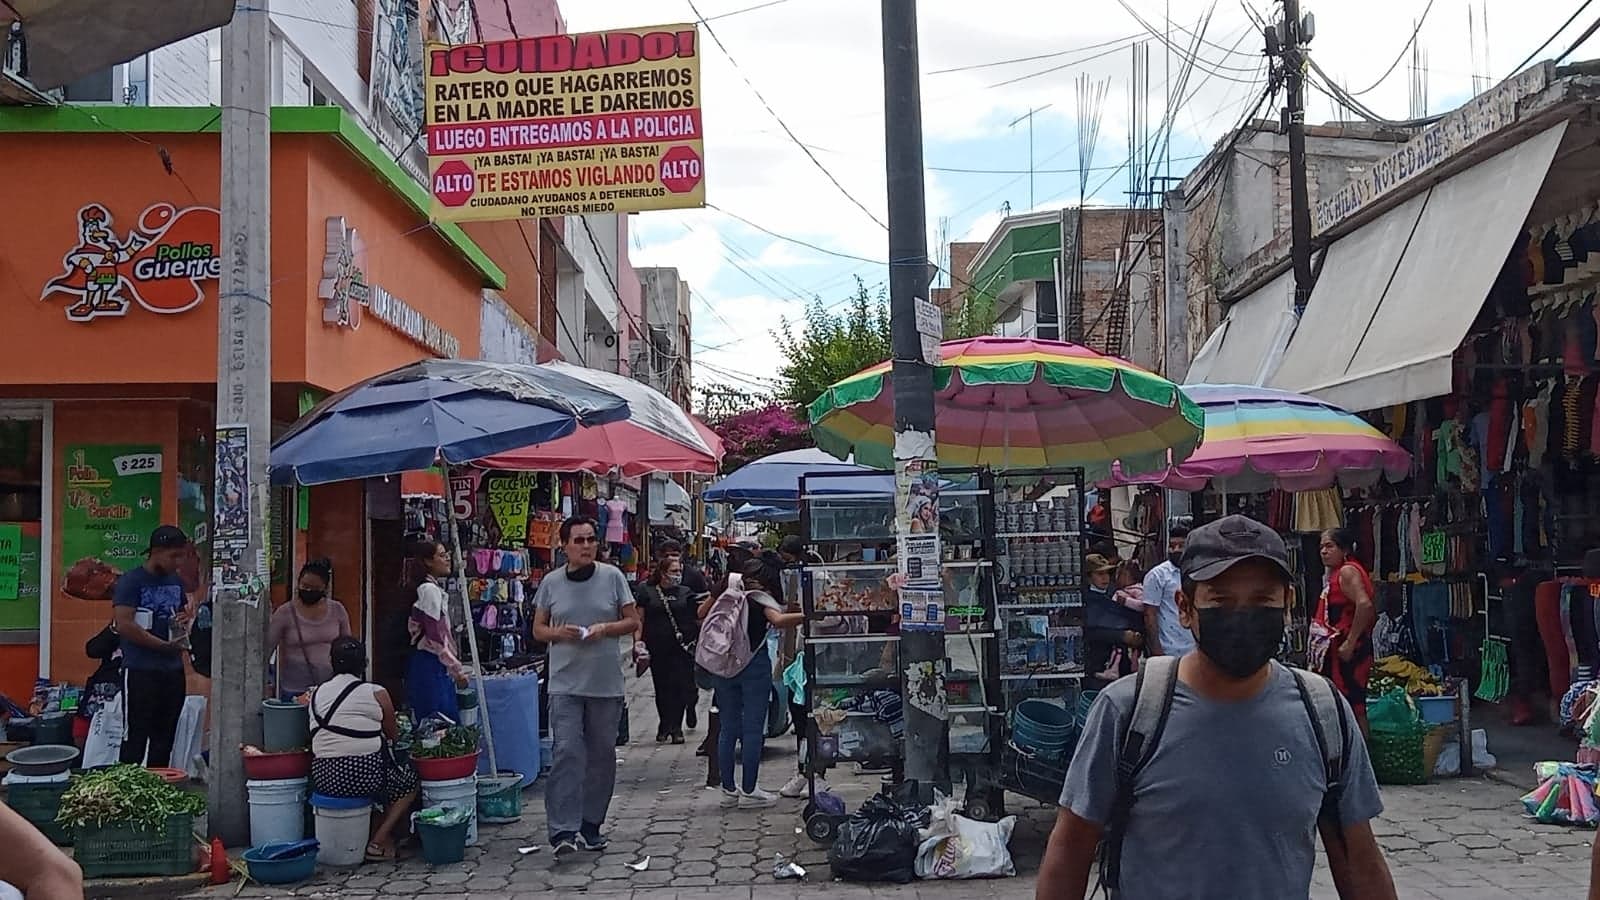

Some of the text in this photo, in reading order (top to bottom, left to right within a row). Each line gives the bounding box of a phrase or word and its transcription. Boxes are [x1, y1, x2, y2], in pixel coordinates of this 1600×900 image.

[430, 31, 695, 76] ¡CUIDADO!
[435, 68, 692, 101] RATERO QUE HAGARREMOS
[435, 89, 694, 123] EN LA MADRE LE DAREMOS
[435, 114, 694, 150] LUEGO ENTREGAMOS A LA POLICIA
[474, 145, 659, 170] ¡YA BASTA! ¡YA BASTA! ¡YA BASTA!
[478, 164, 655, 193] TE ESTAMOS VIGLANDO
[661, 159, 699, 179] ALTO
[435, 174, 473, 193] ALTO
[470, 187, 665, 208] CIUDADANO AYUDANOS A DETENERLOS
[521, 202, 615, 217] NO TENGAS MIEDO
[158, 243, 210, 260] Pollos
[121, 457, 155, 471] $ 225
[519, 474, 536, 488] 100
[509, 504, 522, 516] 15
[508, 525, 523, 537] 25
